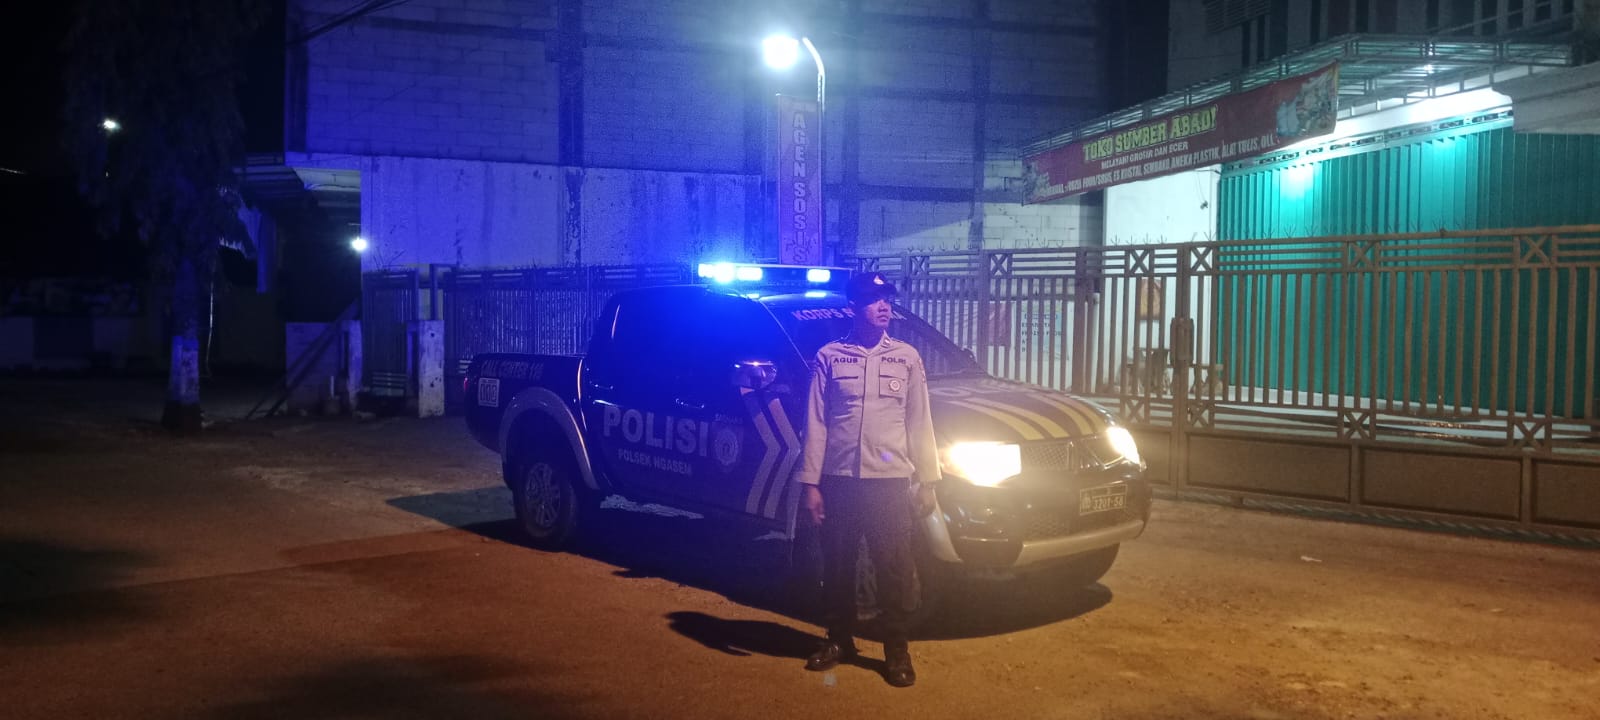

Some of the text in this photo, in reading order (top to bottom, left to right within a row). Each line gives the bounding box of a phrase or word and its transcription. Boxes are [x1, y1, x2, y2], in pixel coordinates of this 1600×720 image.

[792, 112, 807, 177] AGEN
[1083, 136, 1114, 161] TOKO
[1115, 122, 1168, 152] SUMBER
[1154, 146, 1168, 157] DAN
[1169, 141, 1189, 153] ECER
[791, 308, 843, 321] KORPS
[603, 405, 709, 457] POLISI
[618, 448, 650, 466] POLSEK
